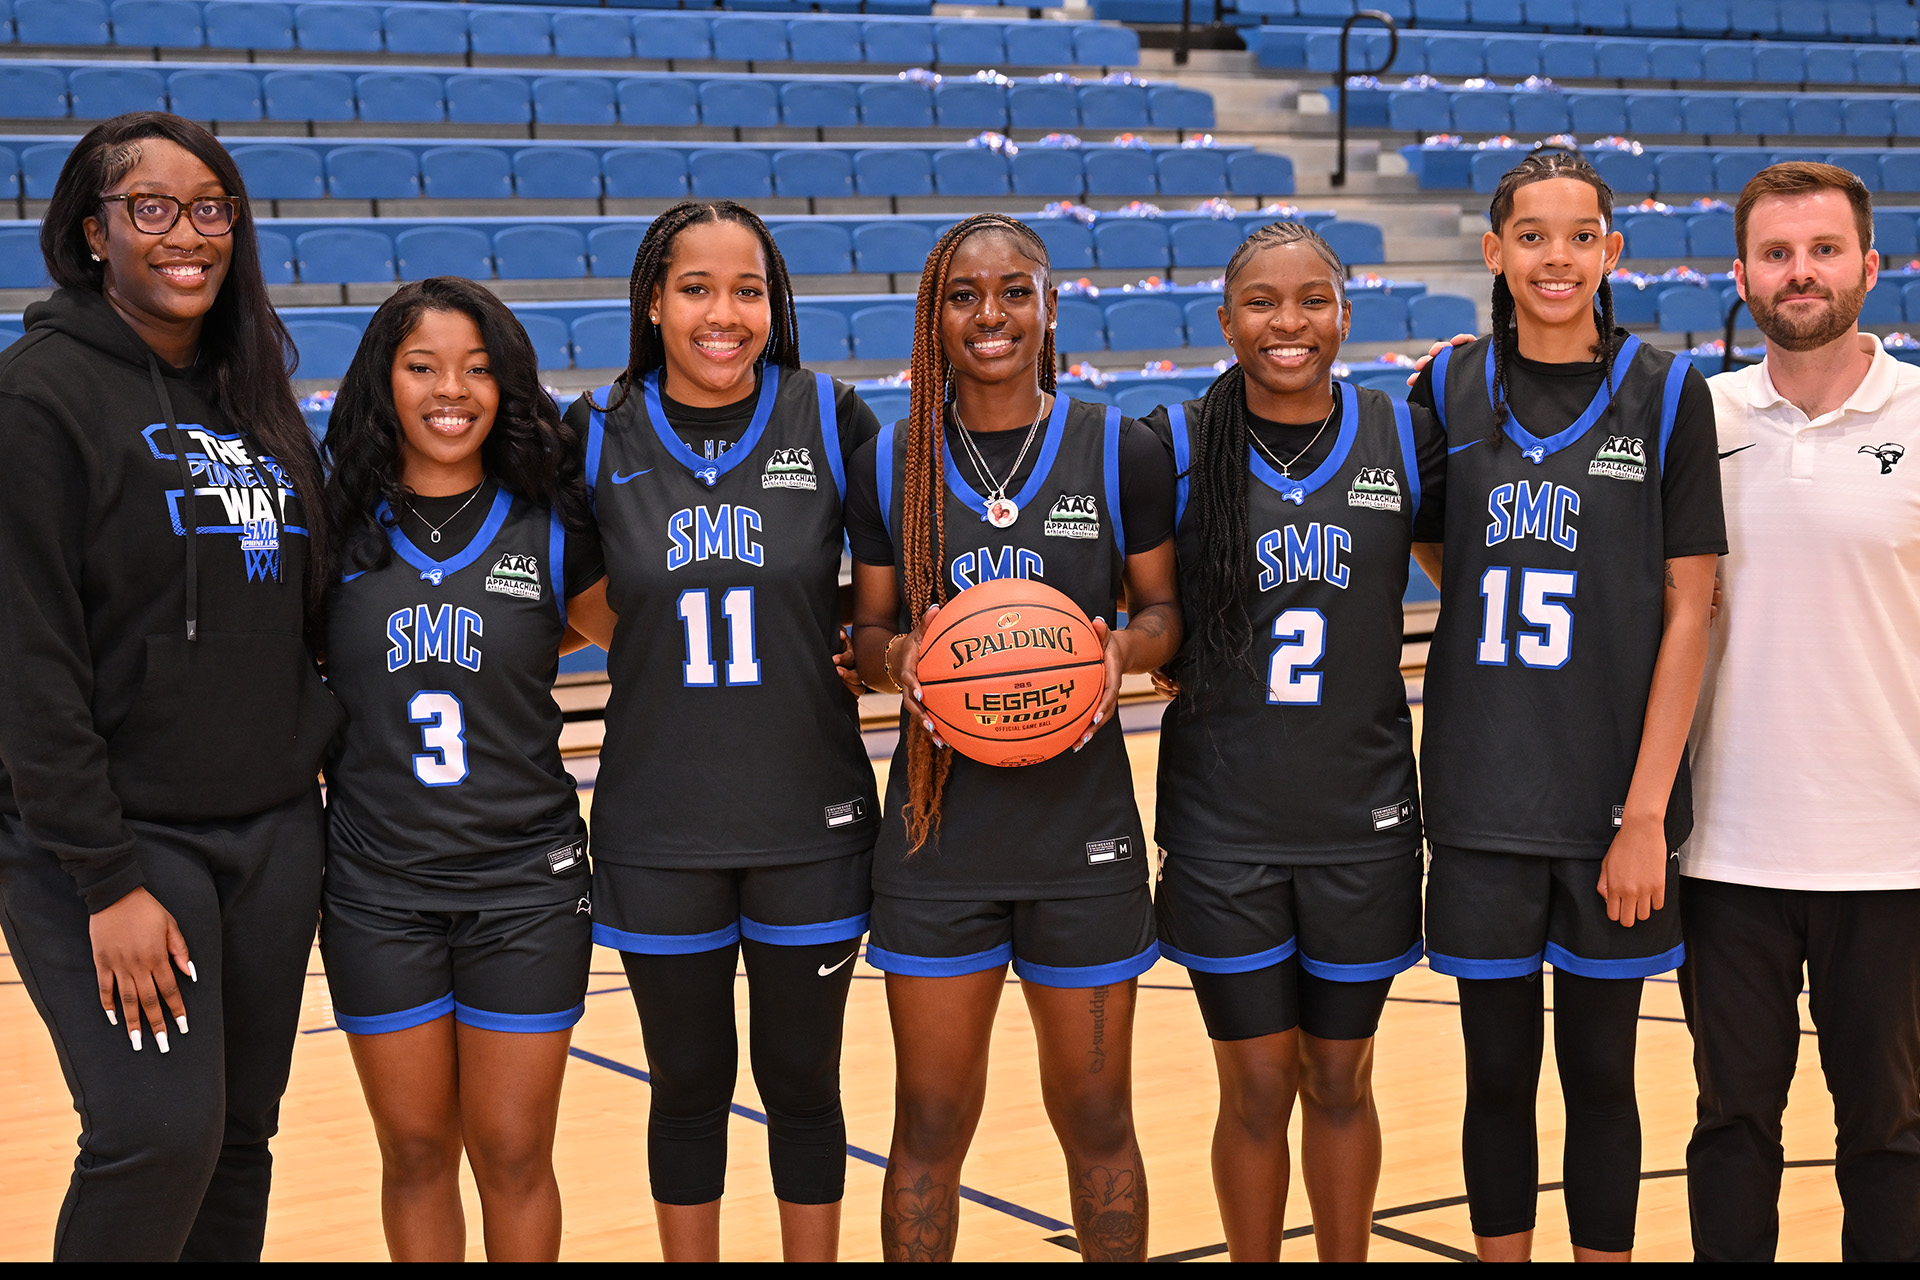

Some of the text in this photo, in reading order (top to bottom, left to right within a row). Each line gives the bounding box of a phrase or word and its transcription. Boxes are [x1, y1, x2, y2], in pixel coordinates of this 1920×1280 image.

[187, 431, 254, 466] THE
[1603, 436, 1643, 457] AAC
[771, 449, 810, 466] AAC
[763, 474, 817, 484] APPALACHIAN
[1358, 468, 1395, 487] AAC
[1591, 461, 1646, 476] APPALACHIAN
[1056, 496, 1096, 514] AAC
[1349, 493, 1401, 505] APPALACHIAN
[1485, 480, 1580, 552] SMC
[667, 504, 764, 571] SMC
[1045, 522, 1099, 532] APPALACHIAN
[498, 554, 537, 574] AAC
[1256, 522, 1351, 592] SMC
[951, 545, 1044, 594] SMC
[486, 578, 541, 593] APPALACHIAN
[1476, 565, 1578, 670] 15
[387, 604, 483, 673] SMC
[676, 586, 762, 687] 11
[949, 626, 1074, 670] SPALDING
[1266, 607, 1328, 706] 2
[964, 679, 1075, 712] LEGACY
[1002, 703, 1068, 724] 1000
[994, 725, 1021, 733] OFFICIAL
[1038, 720, 1052, 728] BALL
[407, 690, 470, 787] 3
[856, 805, 863, 815] L
[1401, 806, 1409, 817] M
[1119, 843, 1128, 854] M
